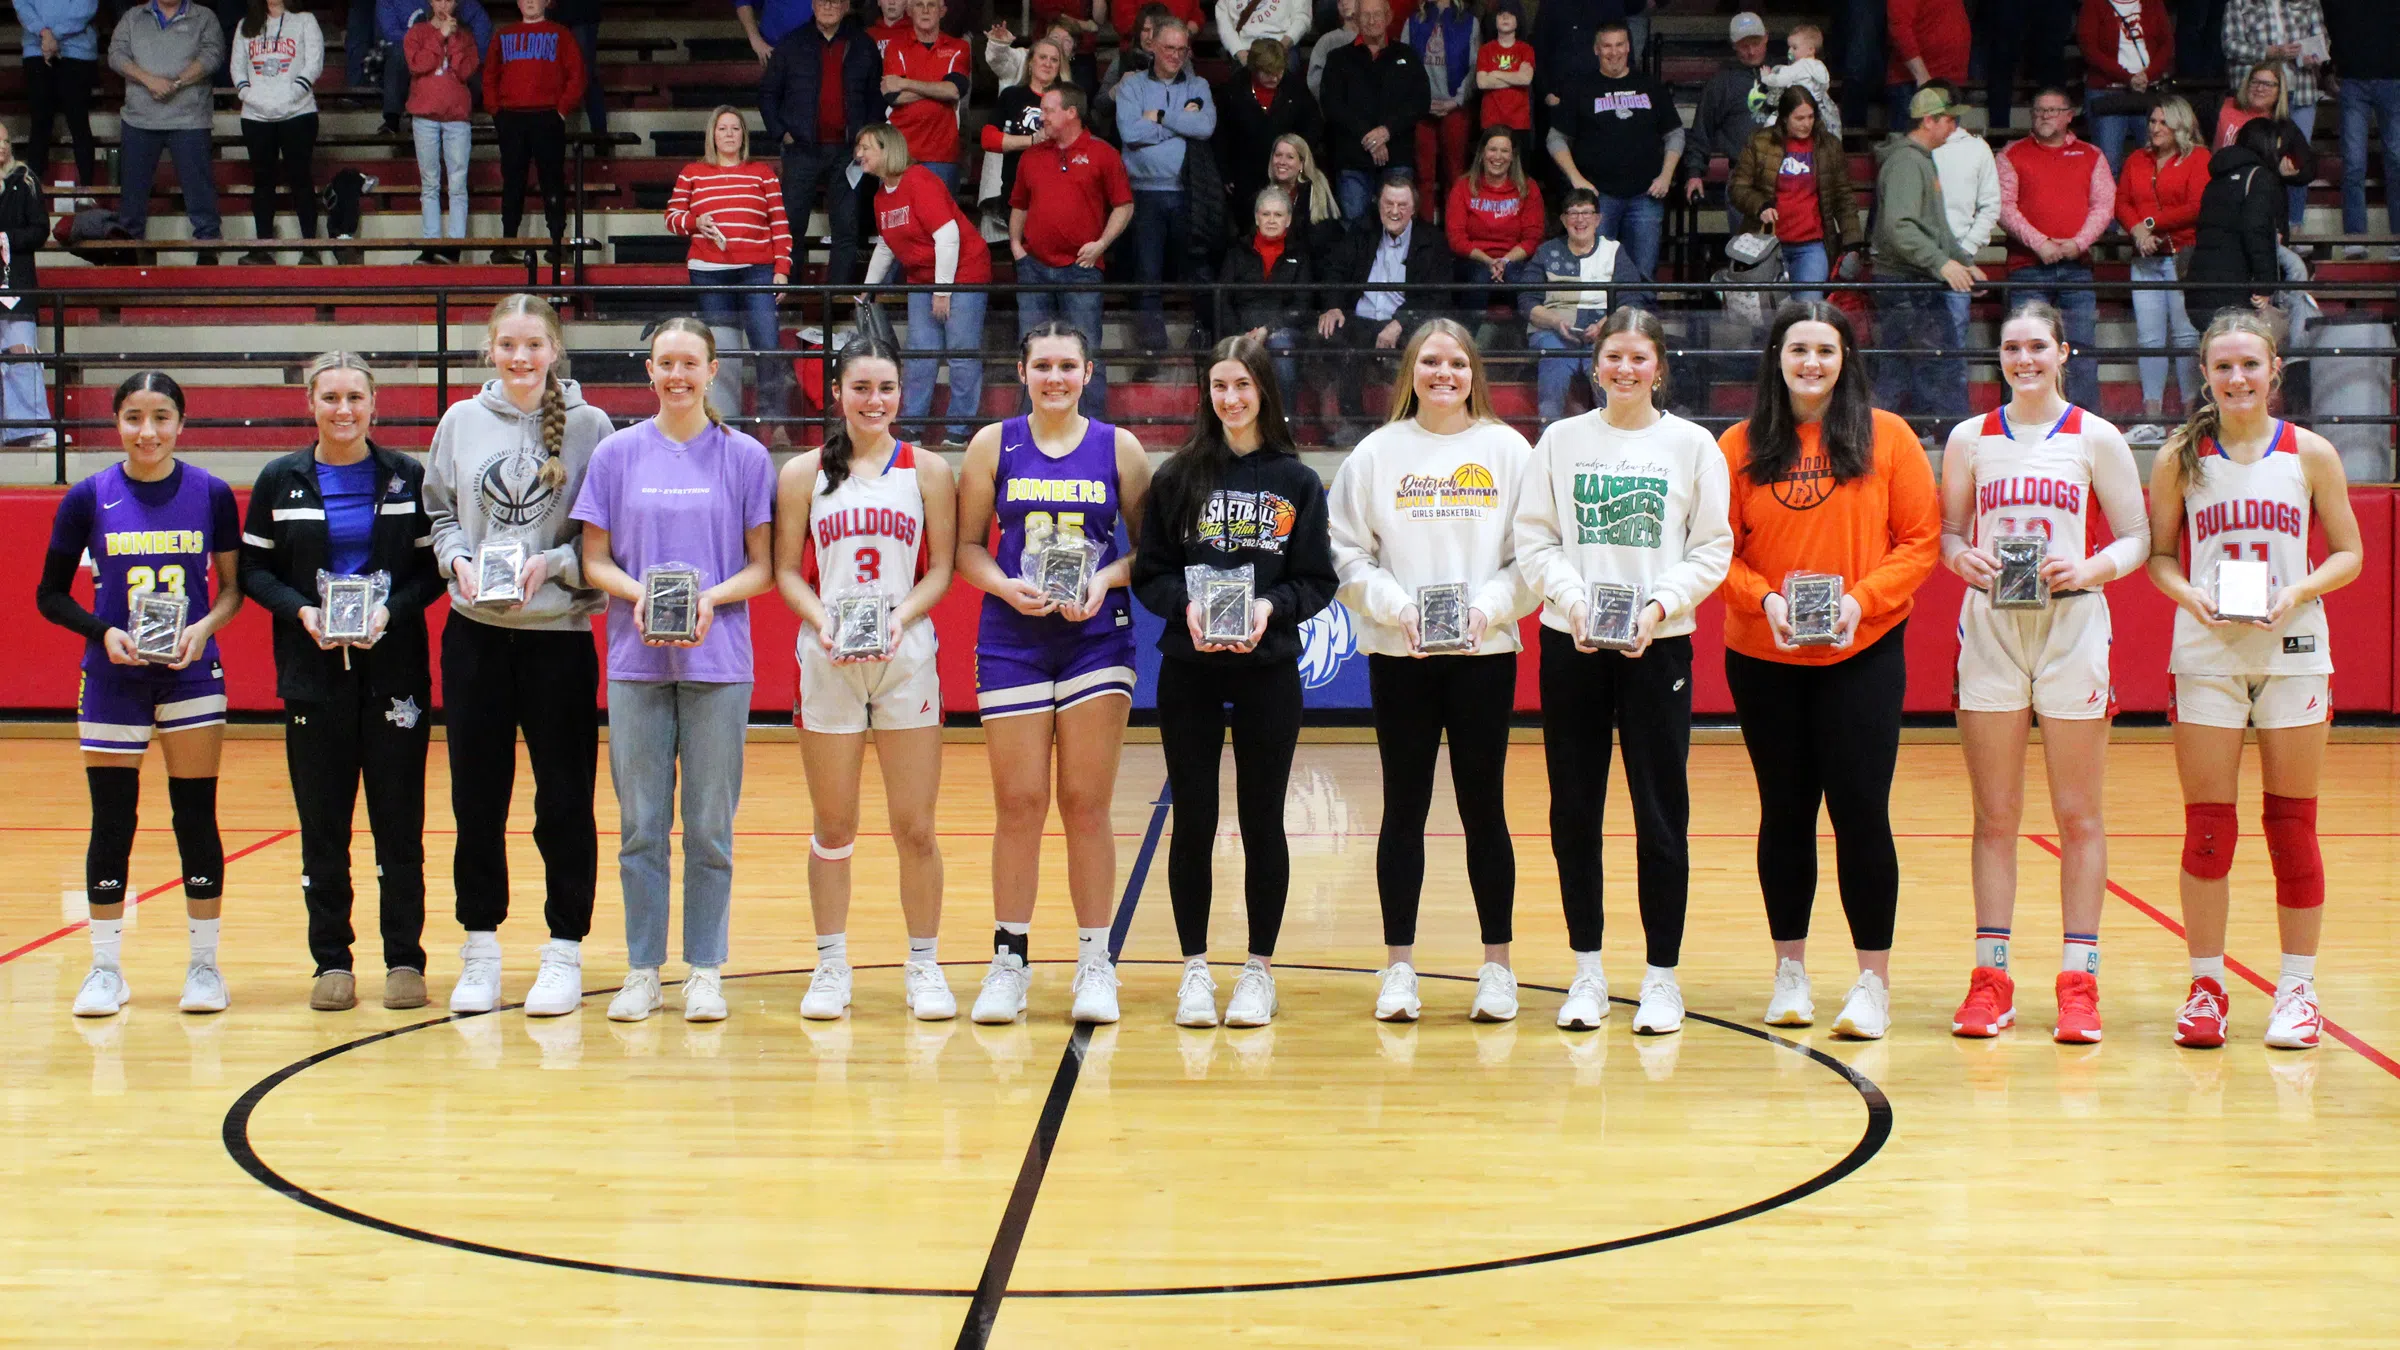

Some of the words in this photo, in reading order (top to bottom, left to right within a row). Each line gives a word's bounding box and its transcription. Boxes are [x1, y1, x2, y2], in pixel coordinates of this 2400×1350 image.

[1594, 93, 1652, 114] BULLDOGS
[663, 487, 711, 495] EVERYTHING
[1006, 477, 1107, 505] BOMBERS
[1400, 474, 1458, 493] Dieterich
[1573, 473, 1668, 505] HATCHETS
[1980, 476, 2081, 516] BULLDOGS
[1412, 508, 1434, 518] GIRLS
[1436, 508, 1482, 517] BASKETBALL
[1574, 491, 1666, 528] HATCHETS
[2195, 498, 2302, 544] BULLDOGS
[104, 530, 205, 557] BOMBERS
[817, 506, 917, 549] BULLDOGS
[1577, 515, 1663, 548] HATCHETS
[854, 546, 882, 585] 3
[127, 564, 187, 612] 23
